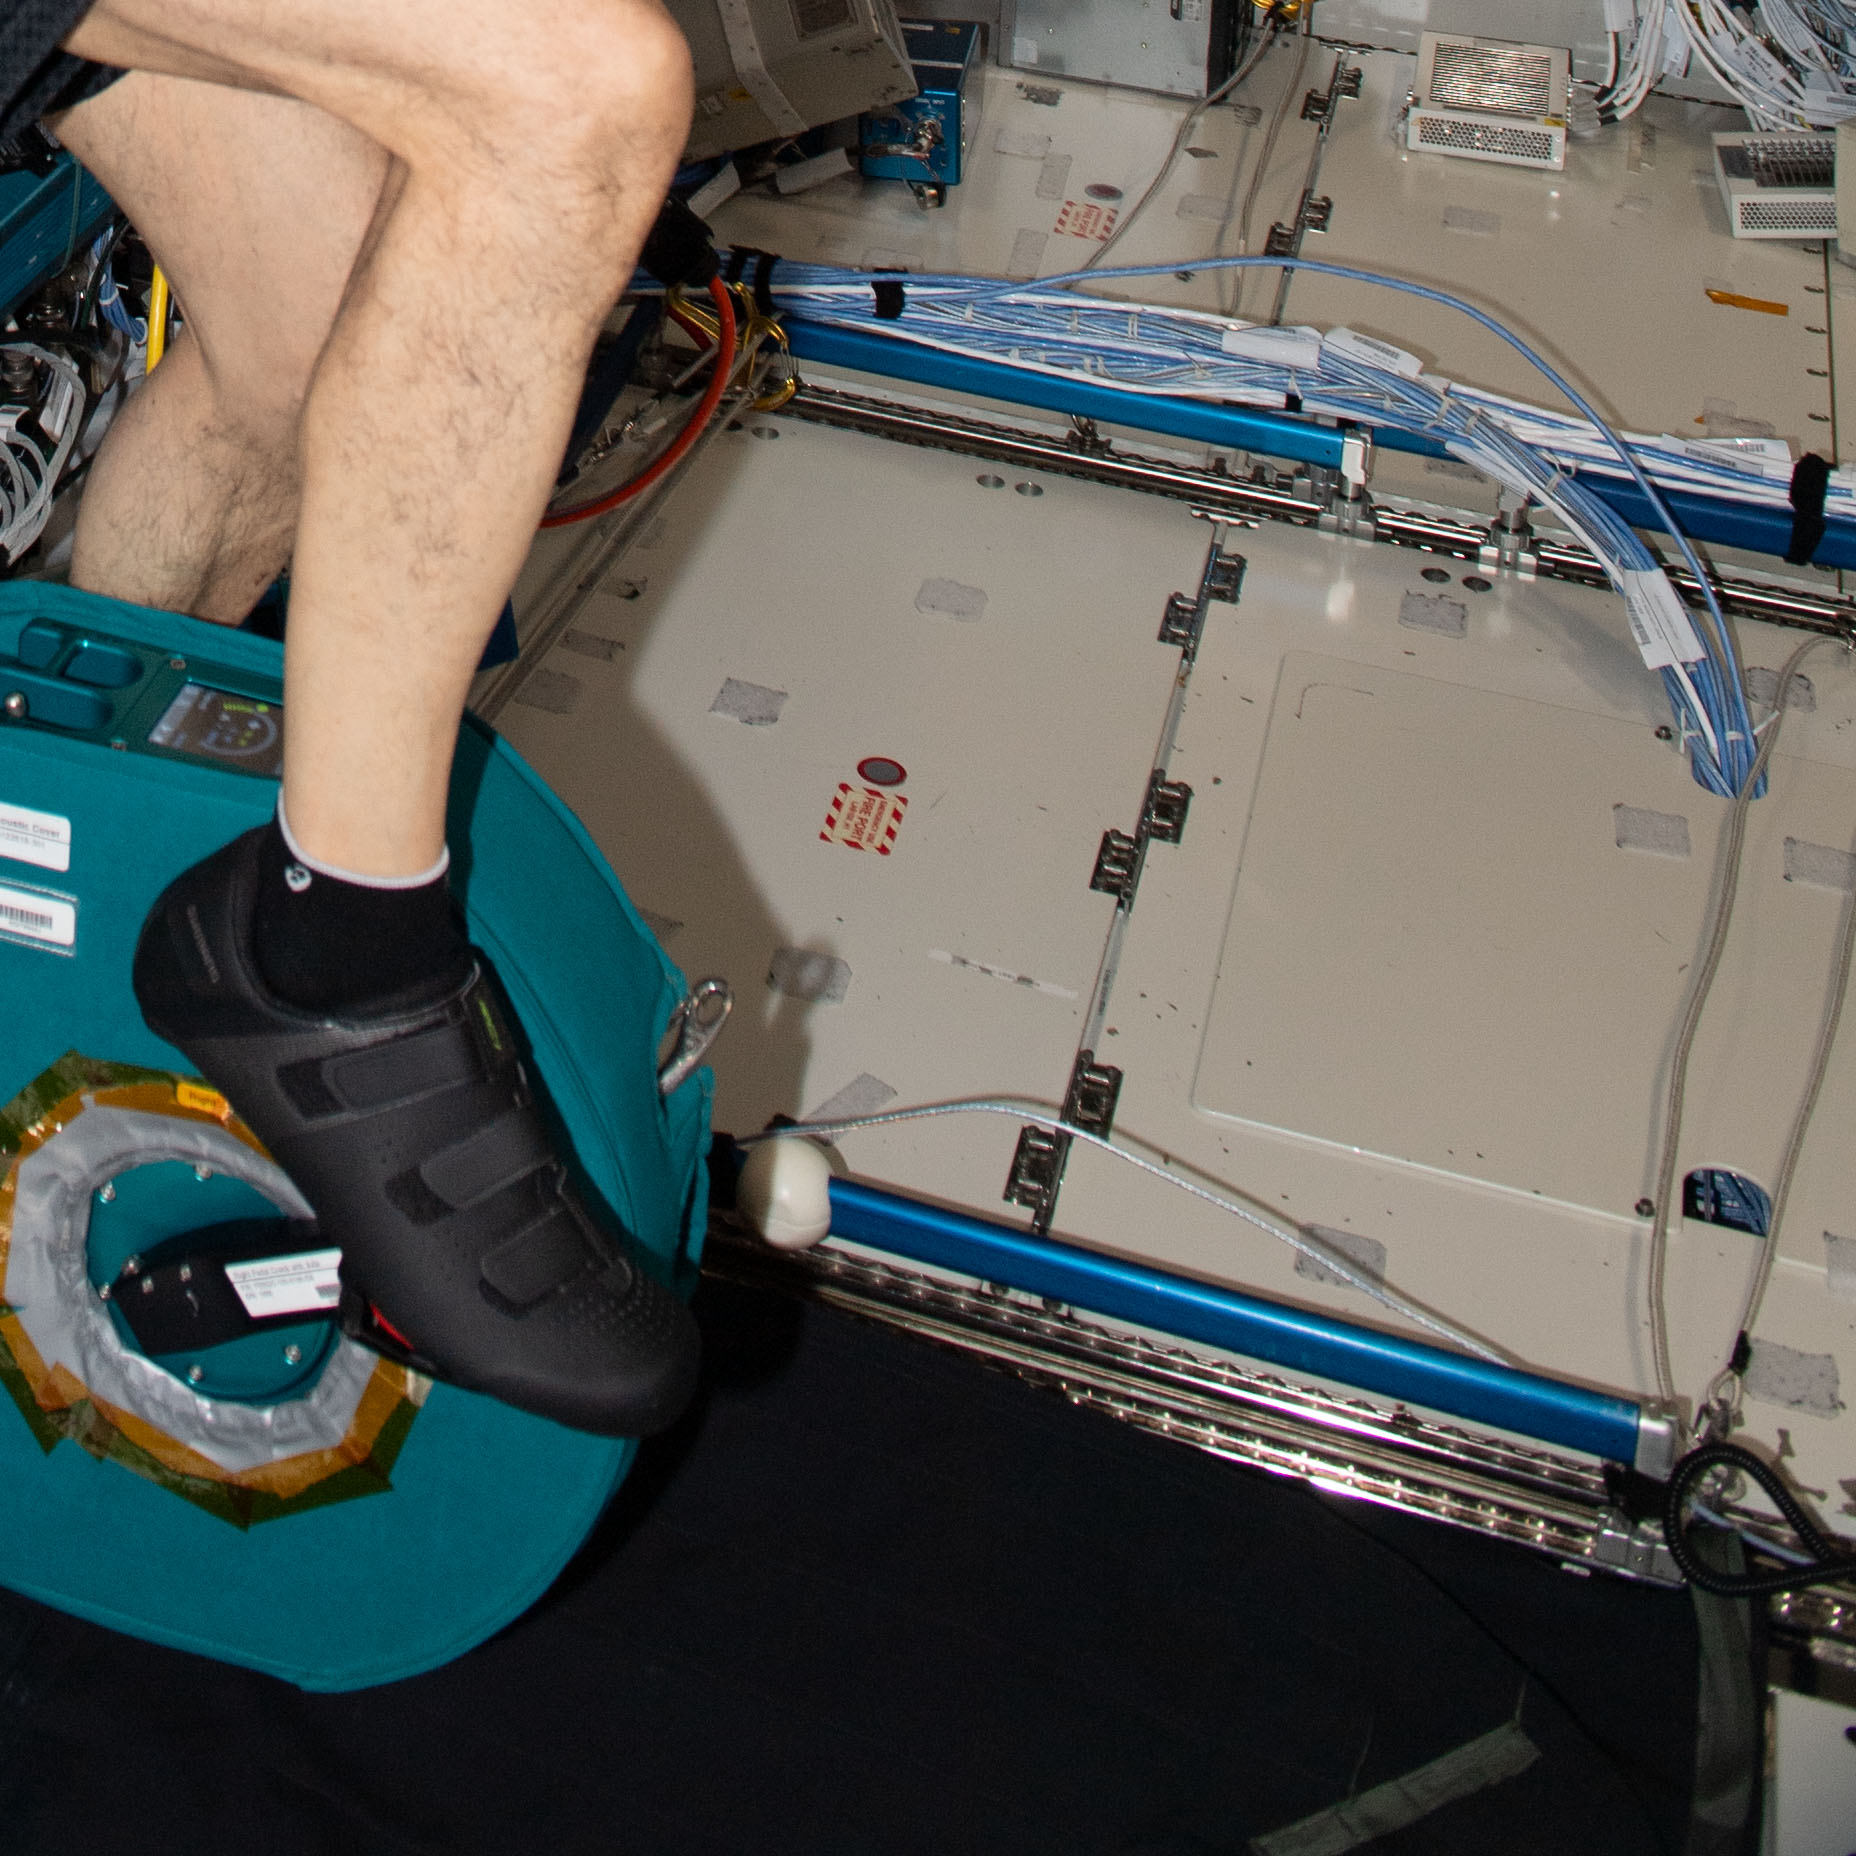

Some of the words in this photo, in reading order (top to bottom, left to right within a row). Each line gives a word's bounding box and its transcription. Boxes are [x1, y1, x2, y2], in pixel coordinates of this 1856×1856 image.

[862, 797, 876, 815] FIRE
[31, 822, 61, 839] Cover
[851, 816, 869, 839] PORT
